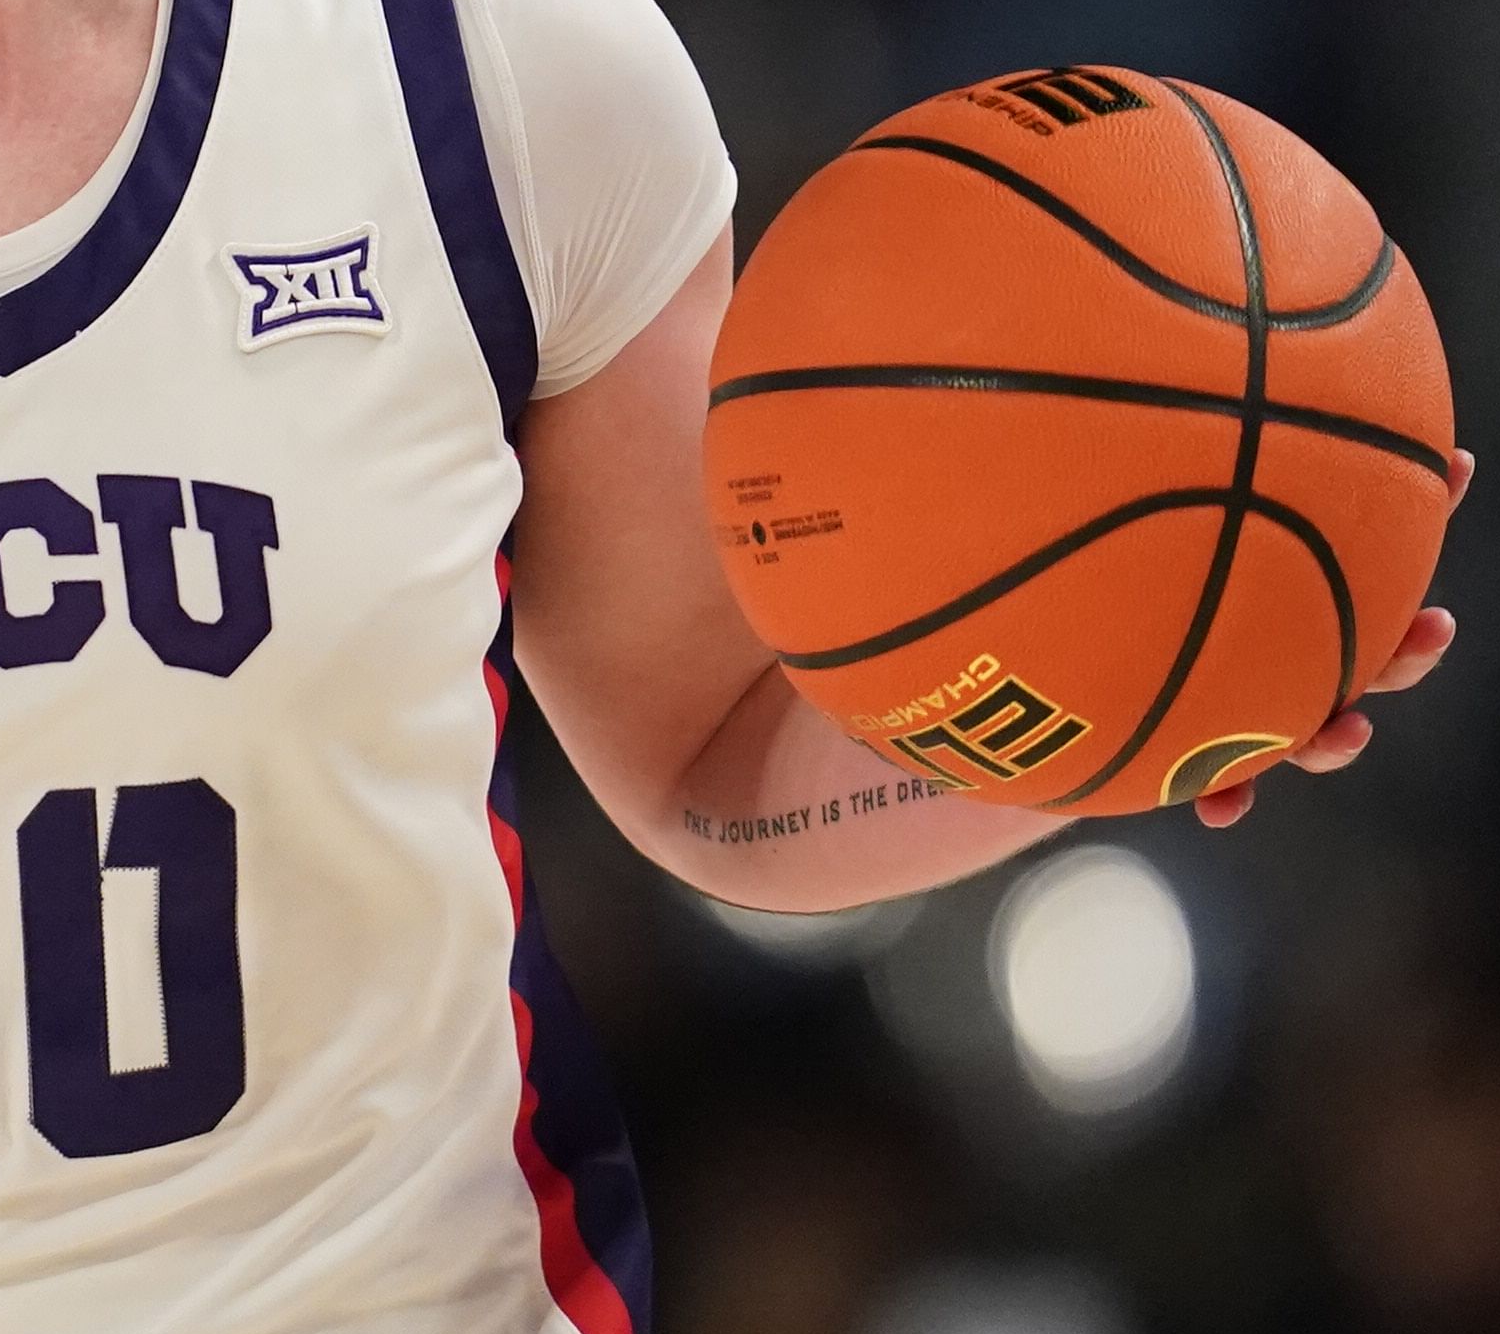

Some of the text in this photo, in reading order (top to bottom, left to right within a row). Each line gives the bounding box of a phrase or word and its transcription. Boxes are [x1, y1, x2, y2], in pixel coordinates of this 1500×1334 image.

[248, 247, 373, 325] XII
[850, 653, 1001, 731] CHAMPIO
[683, 778, 945, 844] THE JOURNEY IS THE DRE
